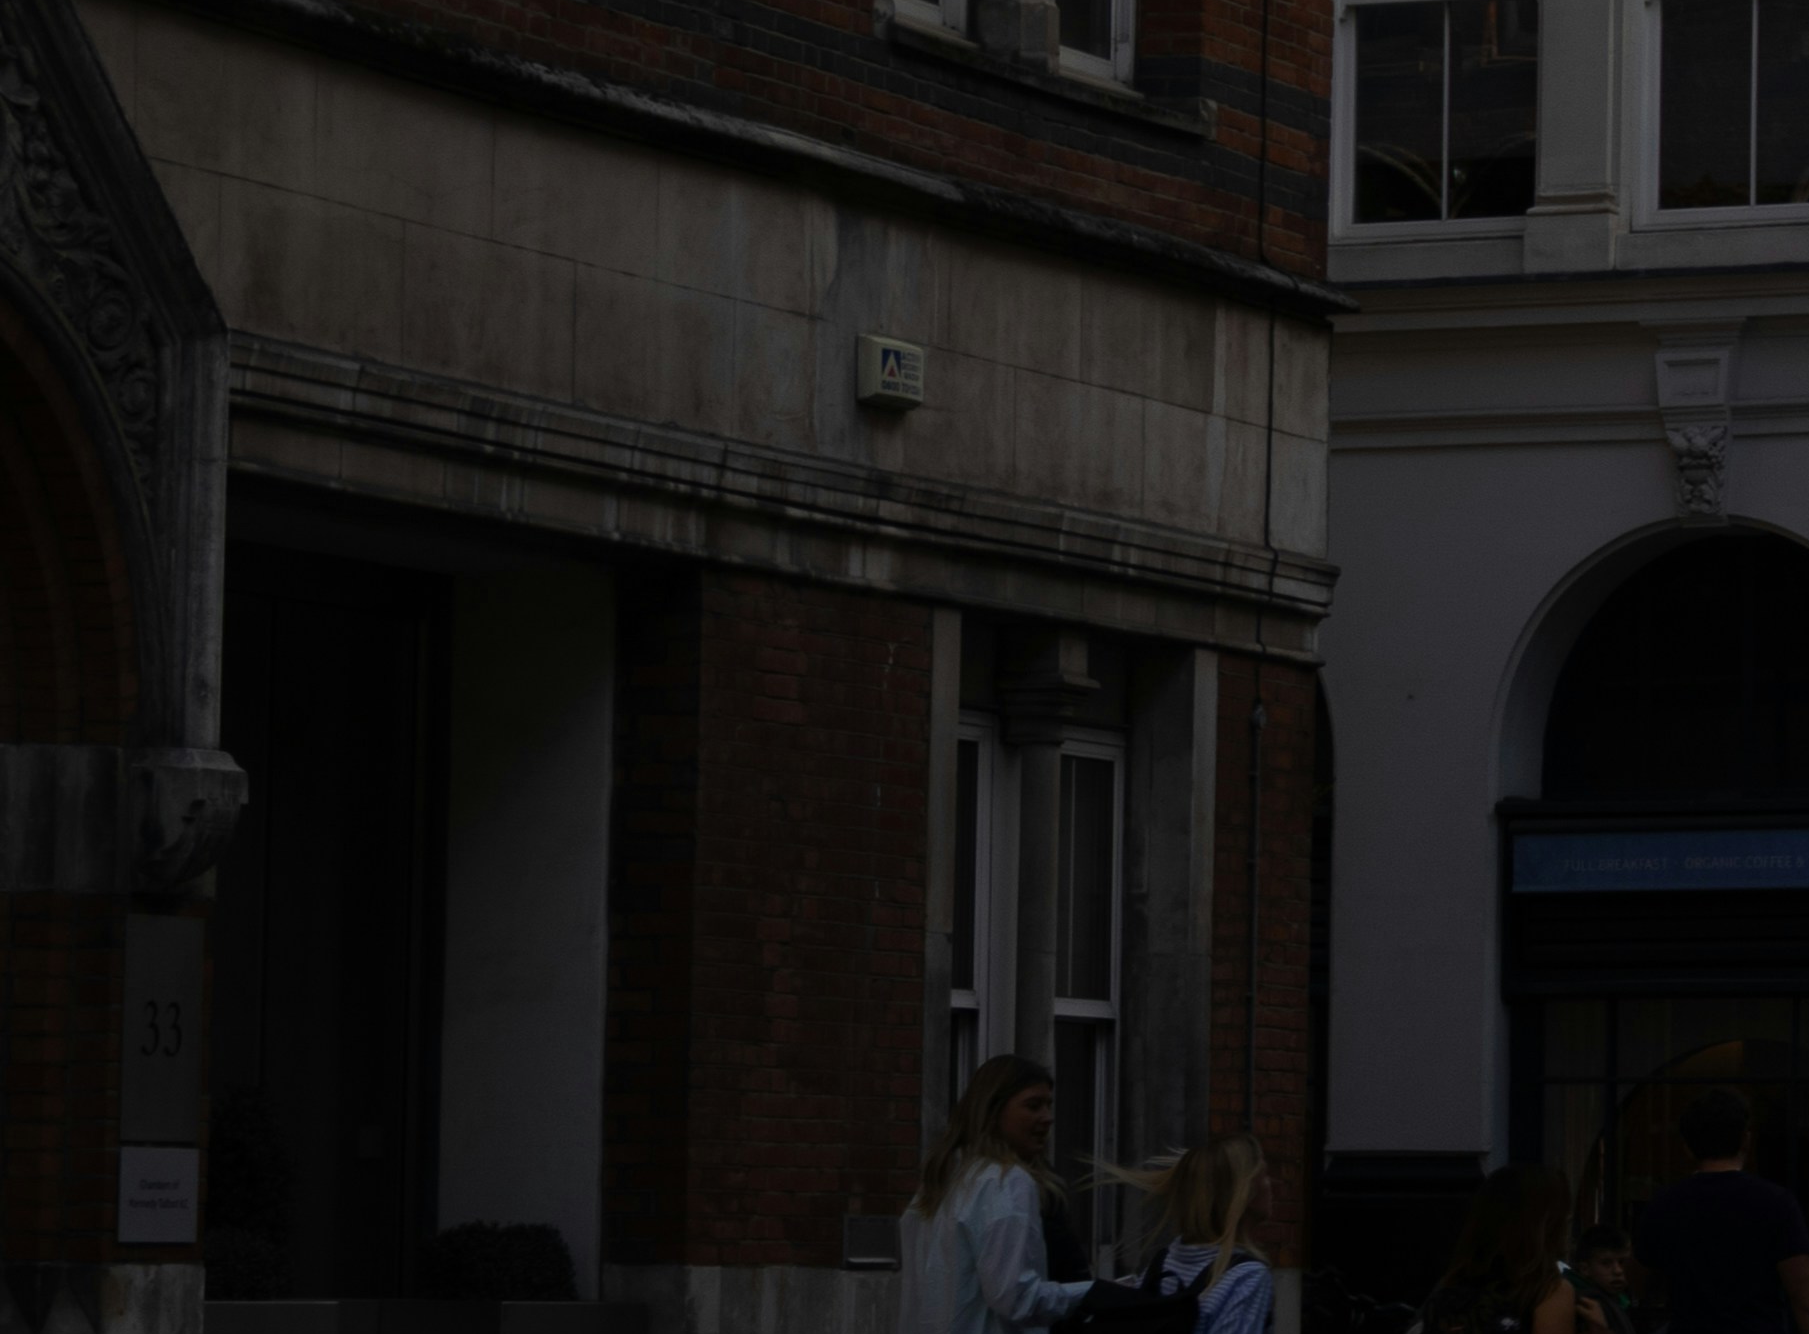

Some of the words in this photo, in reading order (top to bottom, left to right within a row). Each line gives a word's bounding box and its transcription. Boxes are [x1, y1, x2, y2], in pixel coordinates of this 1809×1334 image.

[1563, 859, 1597, 872] FULL
[1598, 857, 1669, 872] BREAKFAST
[1684, 856, 1742, 870] ORGANIC
[1744, 855, 1793, 869] COFFEE
[141, 998, 183, 1058] 33
